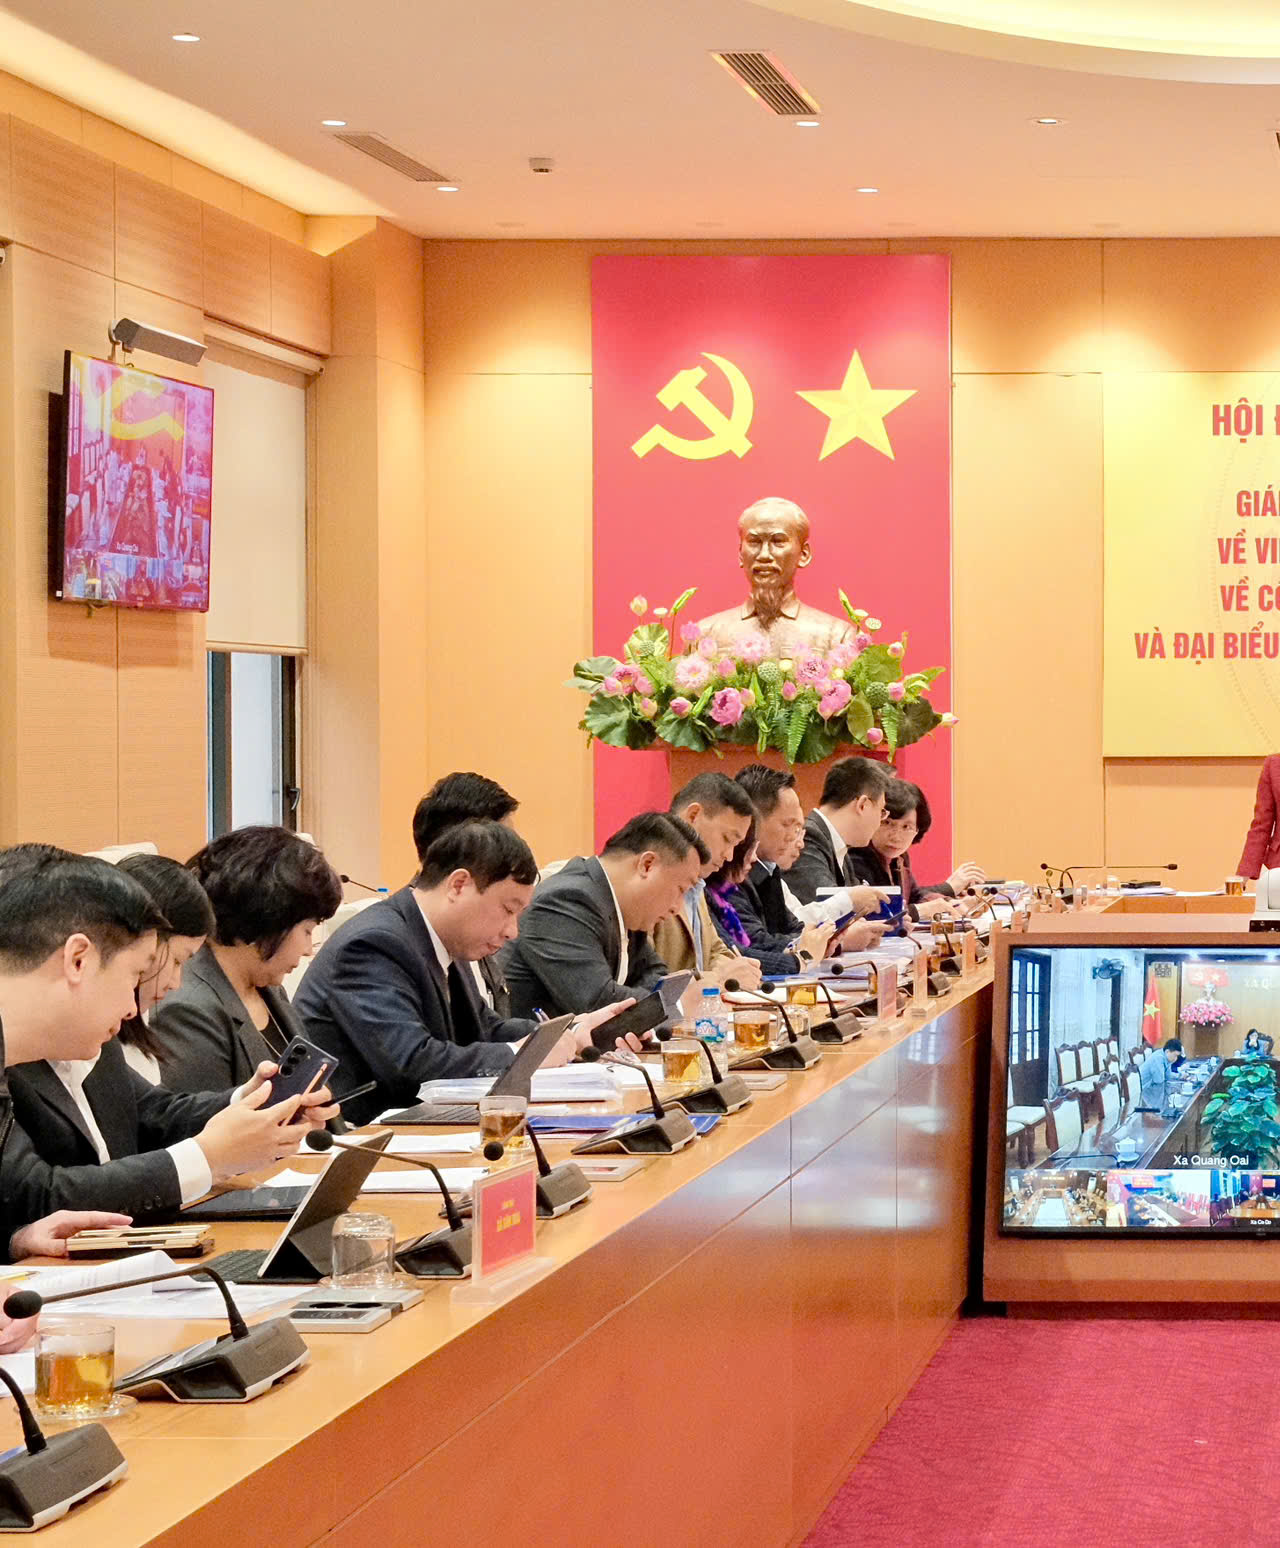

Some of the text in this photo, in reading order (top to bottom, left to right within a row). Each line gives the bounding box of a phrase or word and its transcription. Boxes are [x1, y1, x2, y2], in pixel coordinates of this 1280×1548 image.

[1214, 398, 1262, 443] HỘI
[1218, 530, 1246, 564] VỀ
[1221, 576, 1249, 611] VỀ
[1136, 628, 1166, 659] VÀ
[1174, 633, 1214, 664] ĐẠI
[1224, 623, 1279, 659] BIỂU
[1173, 1155, 1249, 1168] Xa Quang Oai
